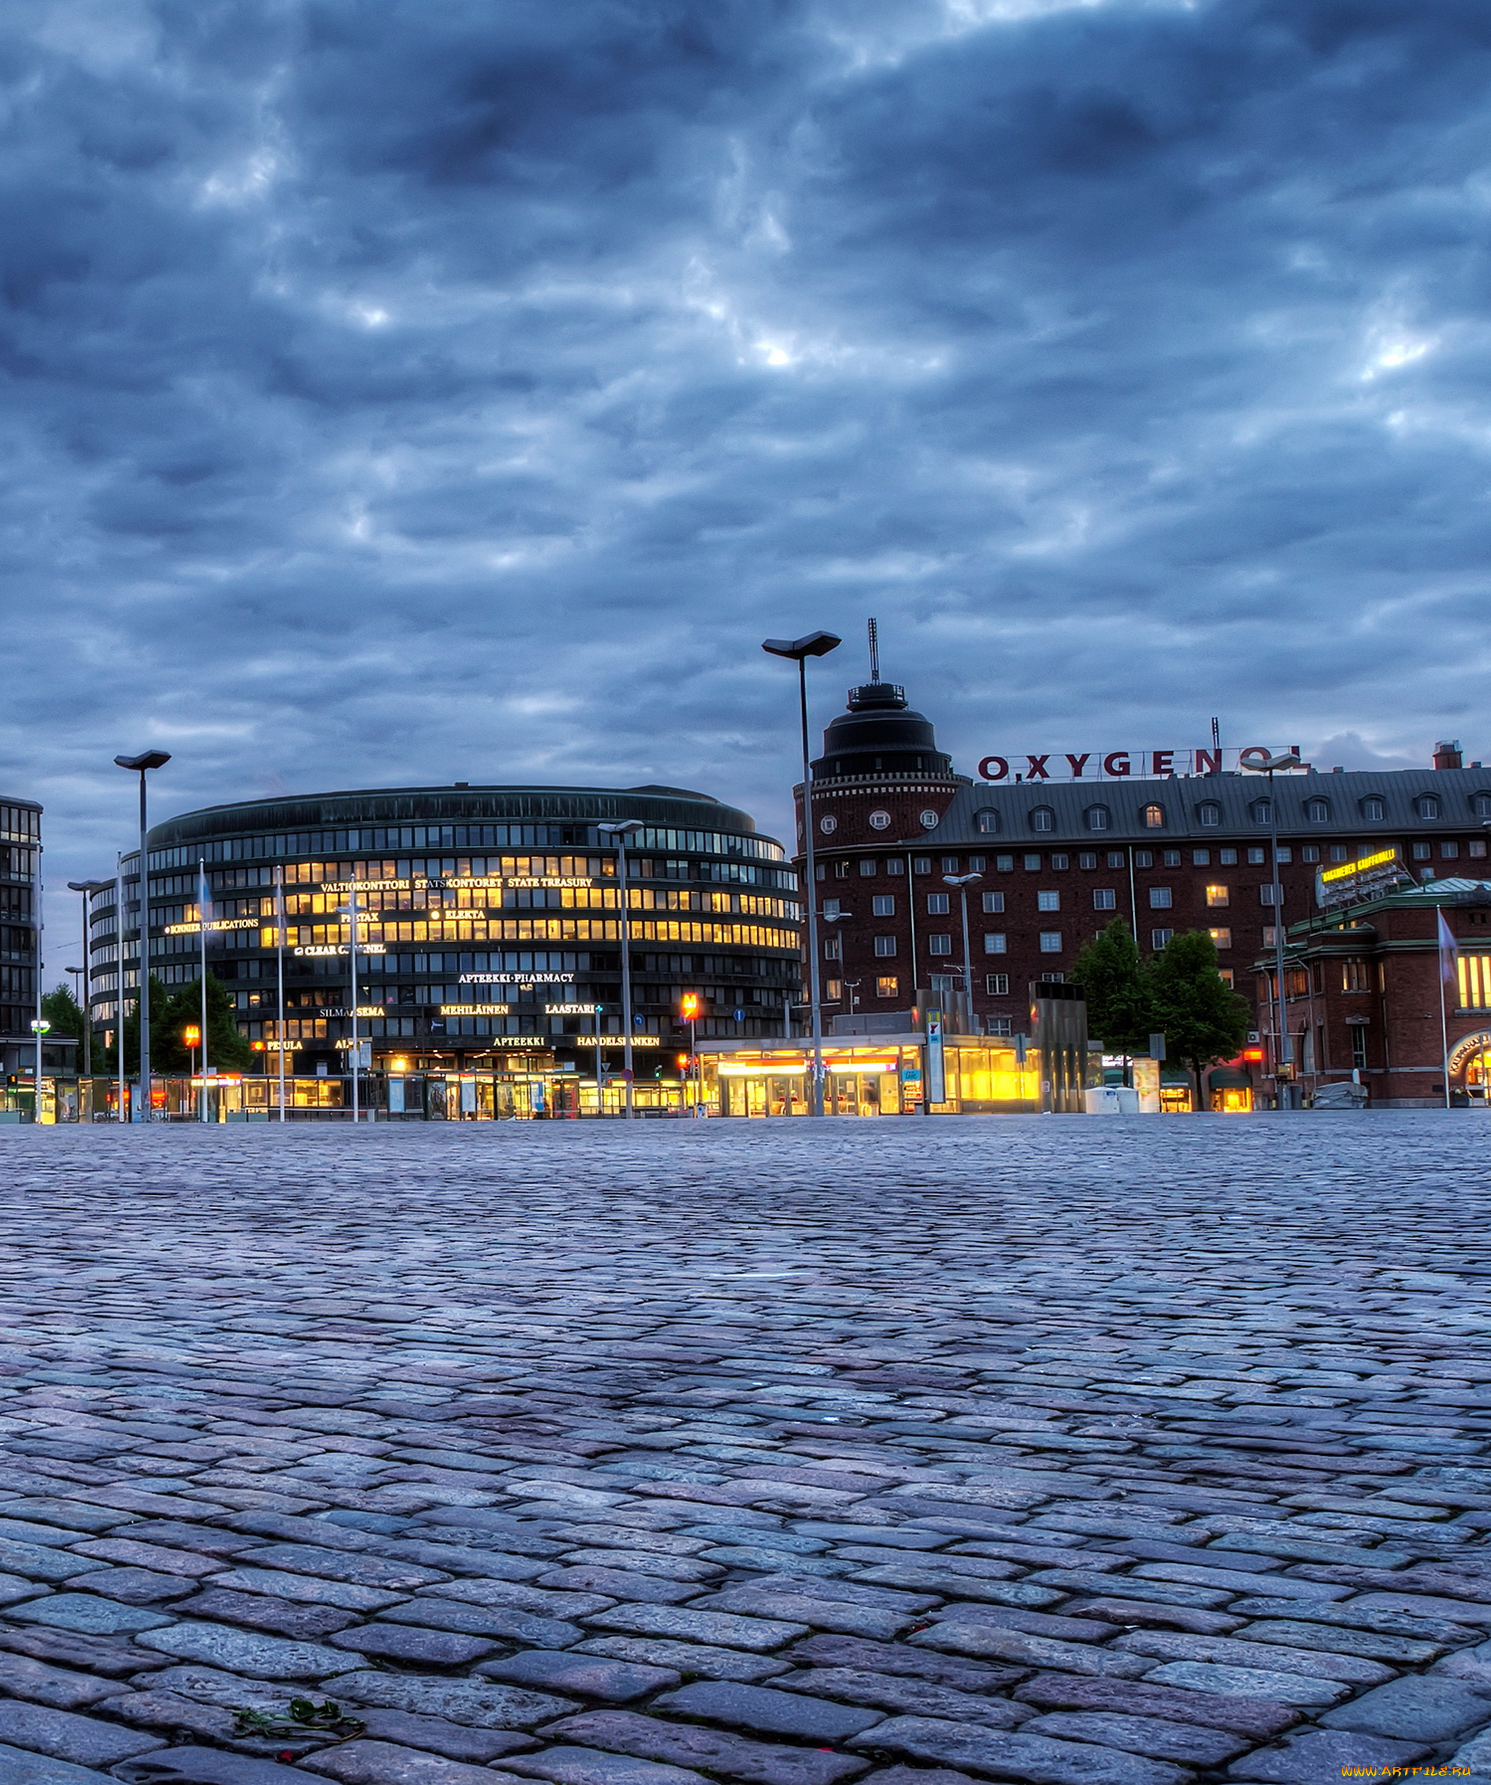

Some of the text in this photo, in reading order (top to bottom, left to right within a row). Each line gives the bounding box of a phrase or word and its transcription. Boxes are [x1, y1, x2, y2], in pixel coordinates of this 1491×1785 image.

[508, 878, 539, 887] STATE
[541, 878, 592, 888] TREASURY
[445, 910, 485, 919] ELEKTA
[305, 945, 337, 955] CLEAR
[440, 1004, 509, 1015] MEHILÄINEN
[545, 1004, 595, 1014] LAASTARI
[493, 1037, 545, 1046] APTEEKKI
